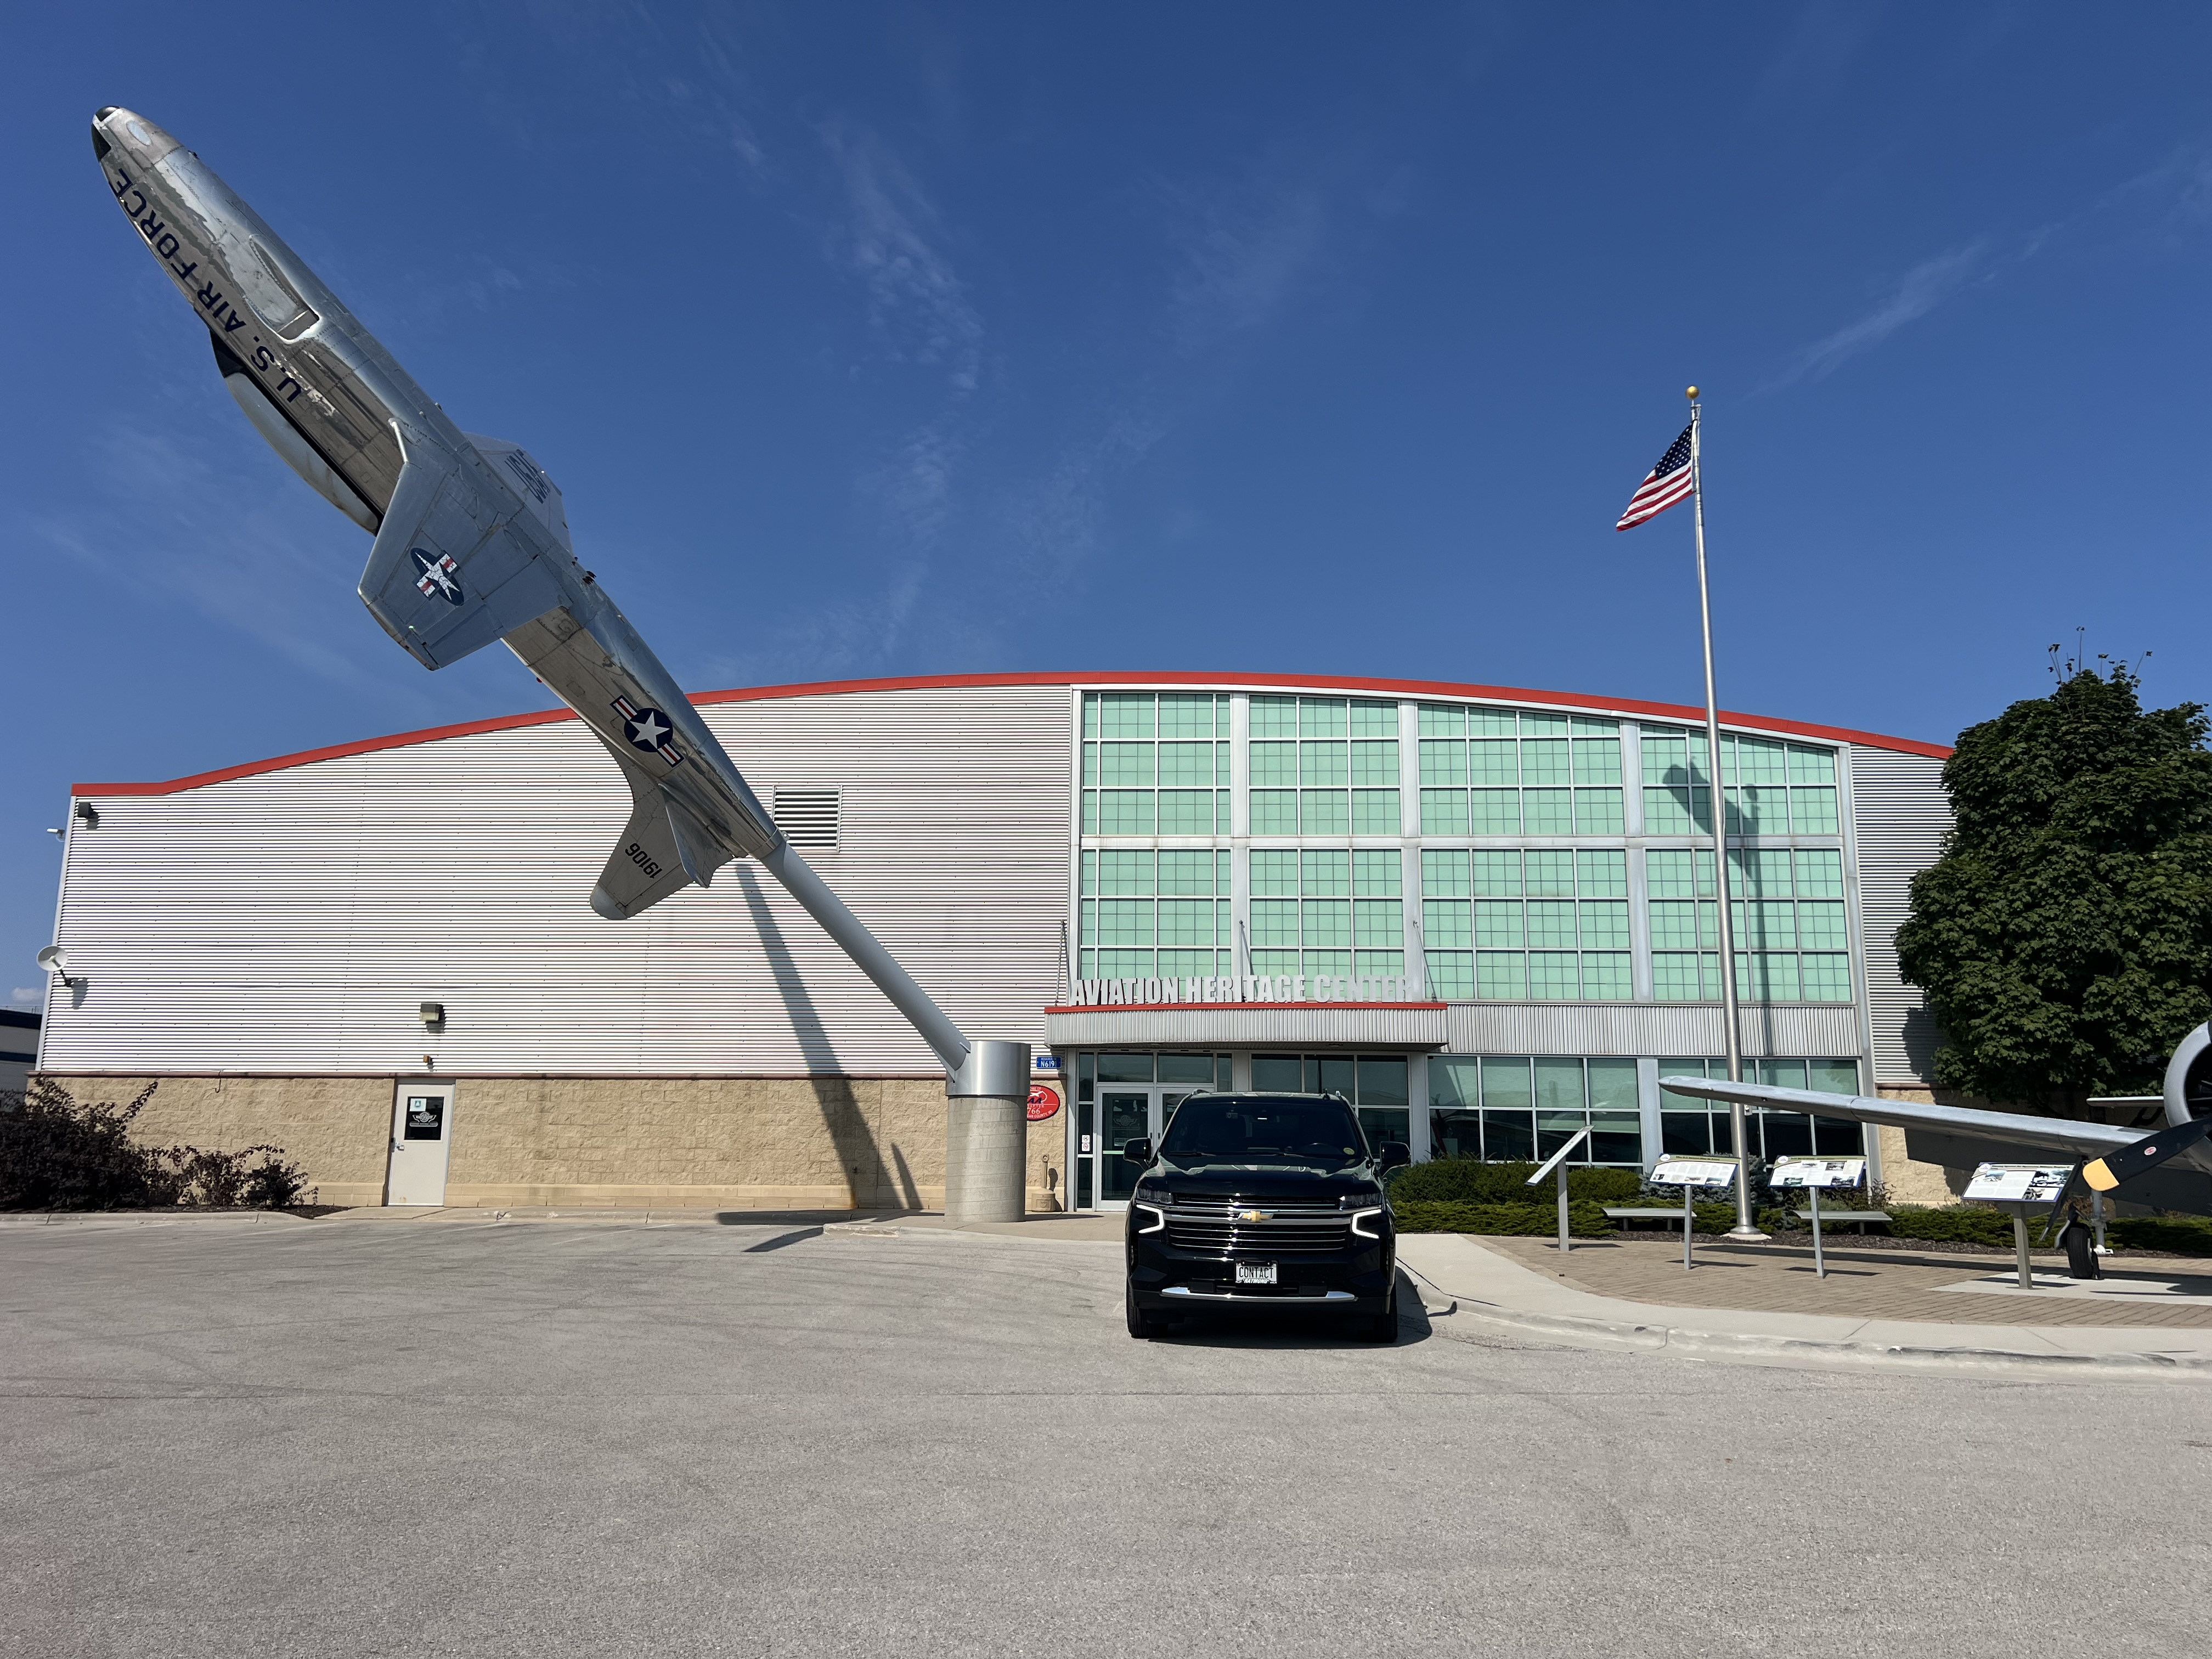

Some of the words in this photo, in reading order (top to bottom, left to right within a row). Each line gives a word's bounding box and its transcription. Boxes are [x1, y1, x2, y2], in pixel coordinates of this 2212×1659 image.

[109, 168, 198, 280] FORCE
[197, 280, 246, 332] AIR
[250, 336, 302, 403] U.S.
[625, 843, 663, 879] 19106
[1070, 976, 1180, 1007] AVIATION
[1186, 974, 1306, 1003] HERITAGE
[1313, 974, 1413, 1003] CENTER
[1239, 1267, 1274, 1278] CONTACT
